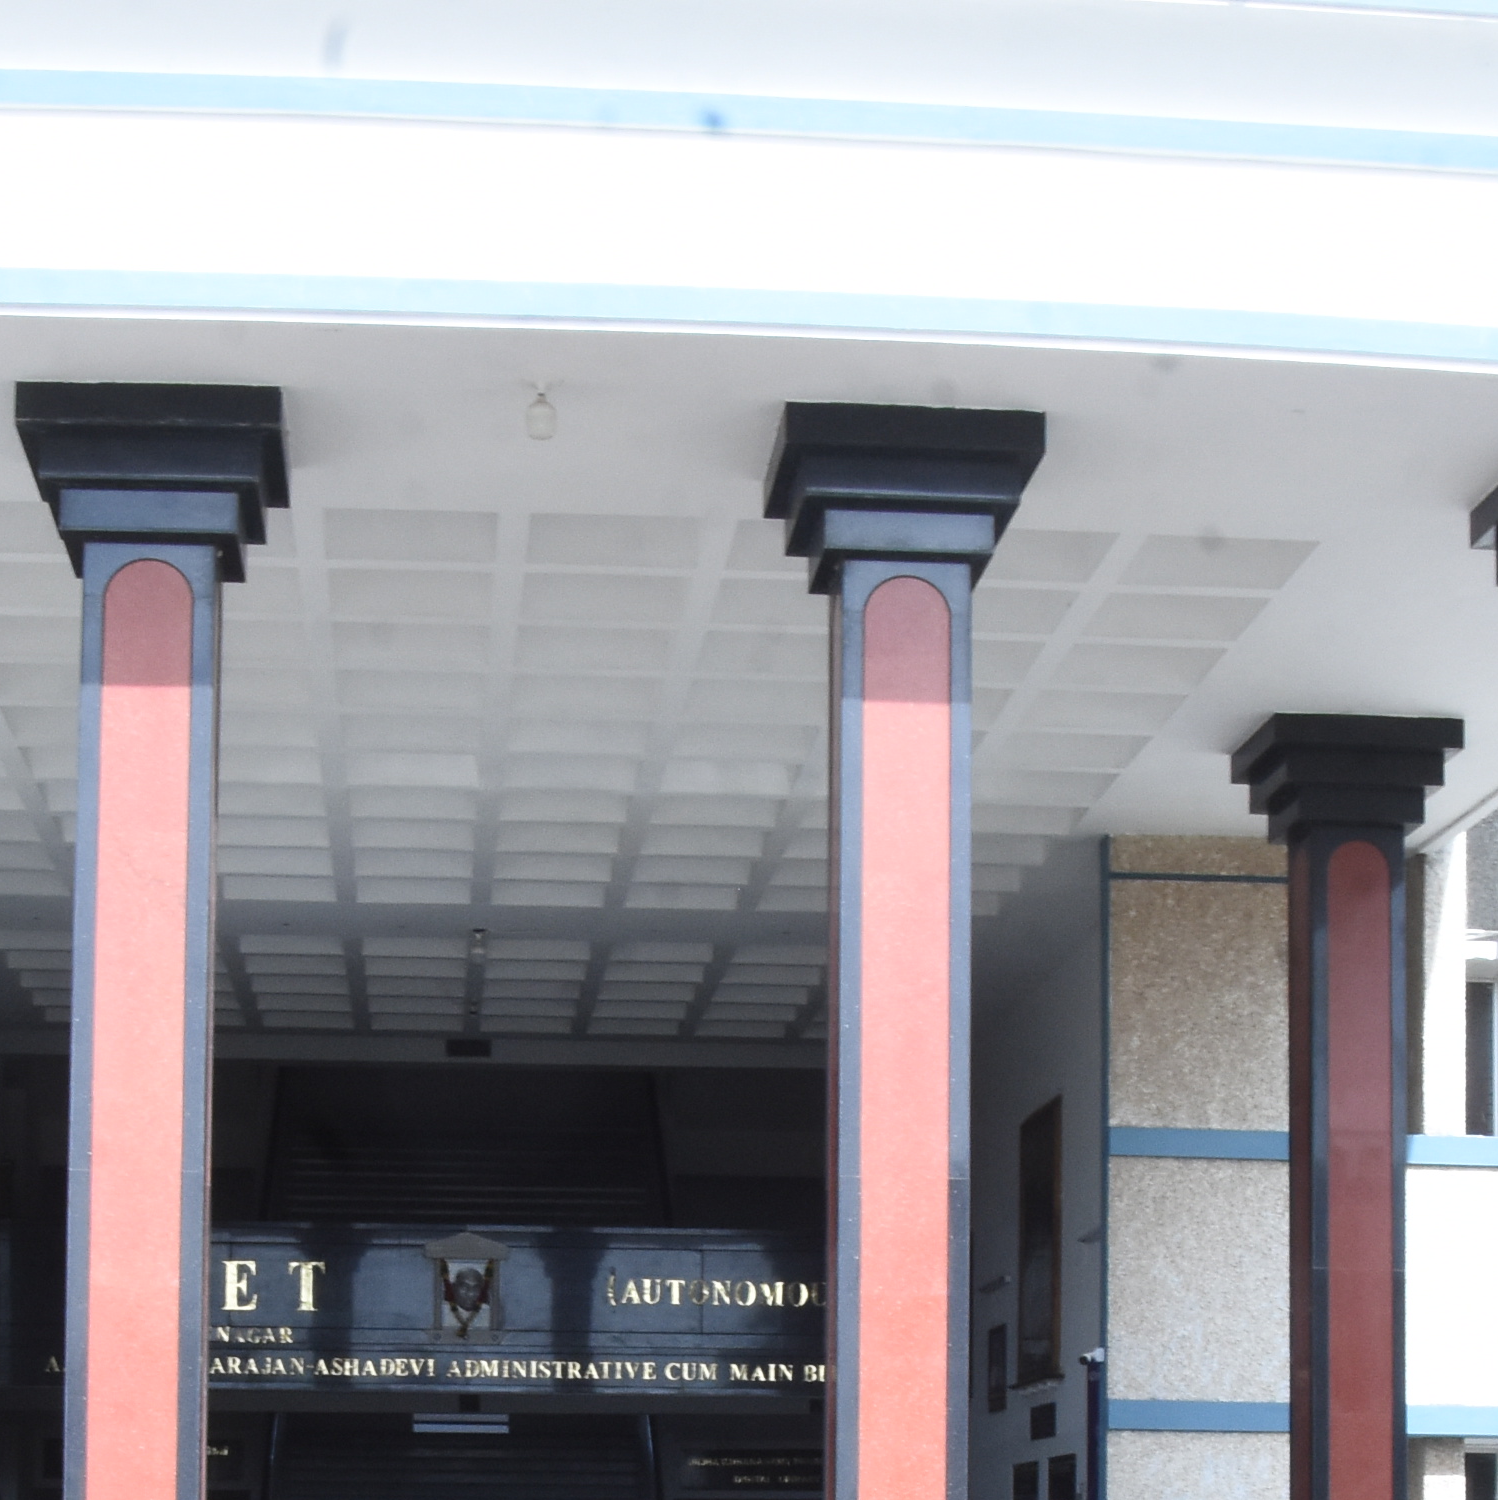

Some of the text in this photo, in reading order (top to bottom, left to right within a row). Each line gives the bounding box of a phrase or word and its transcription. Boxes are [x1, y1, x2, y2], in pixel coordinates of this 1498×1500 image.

[445, 1359, 657, 1381] ADMINISTRATIVE
[663, 1362, 718, 1381] CUM
[729, 1363, 794, 1382] MAIN
